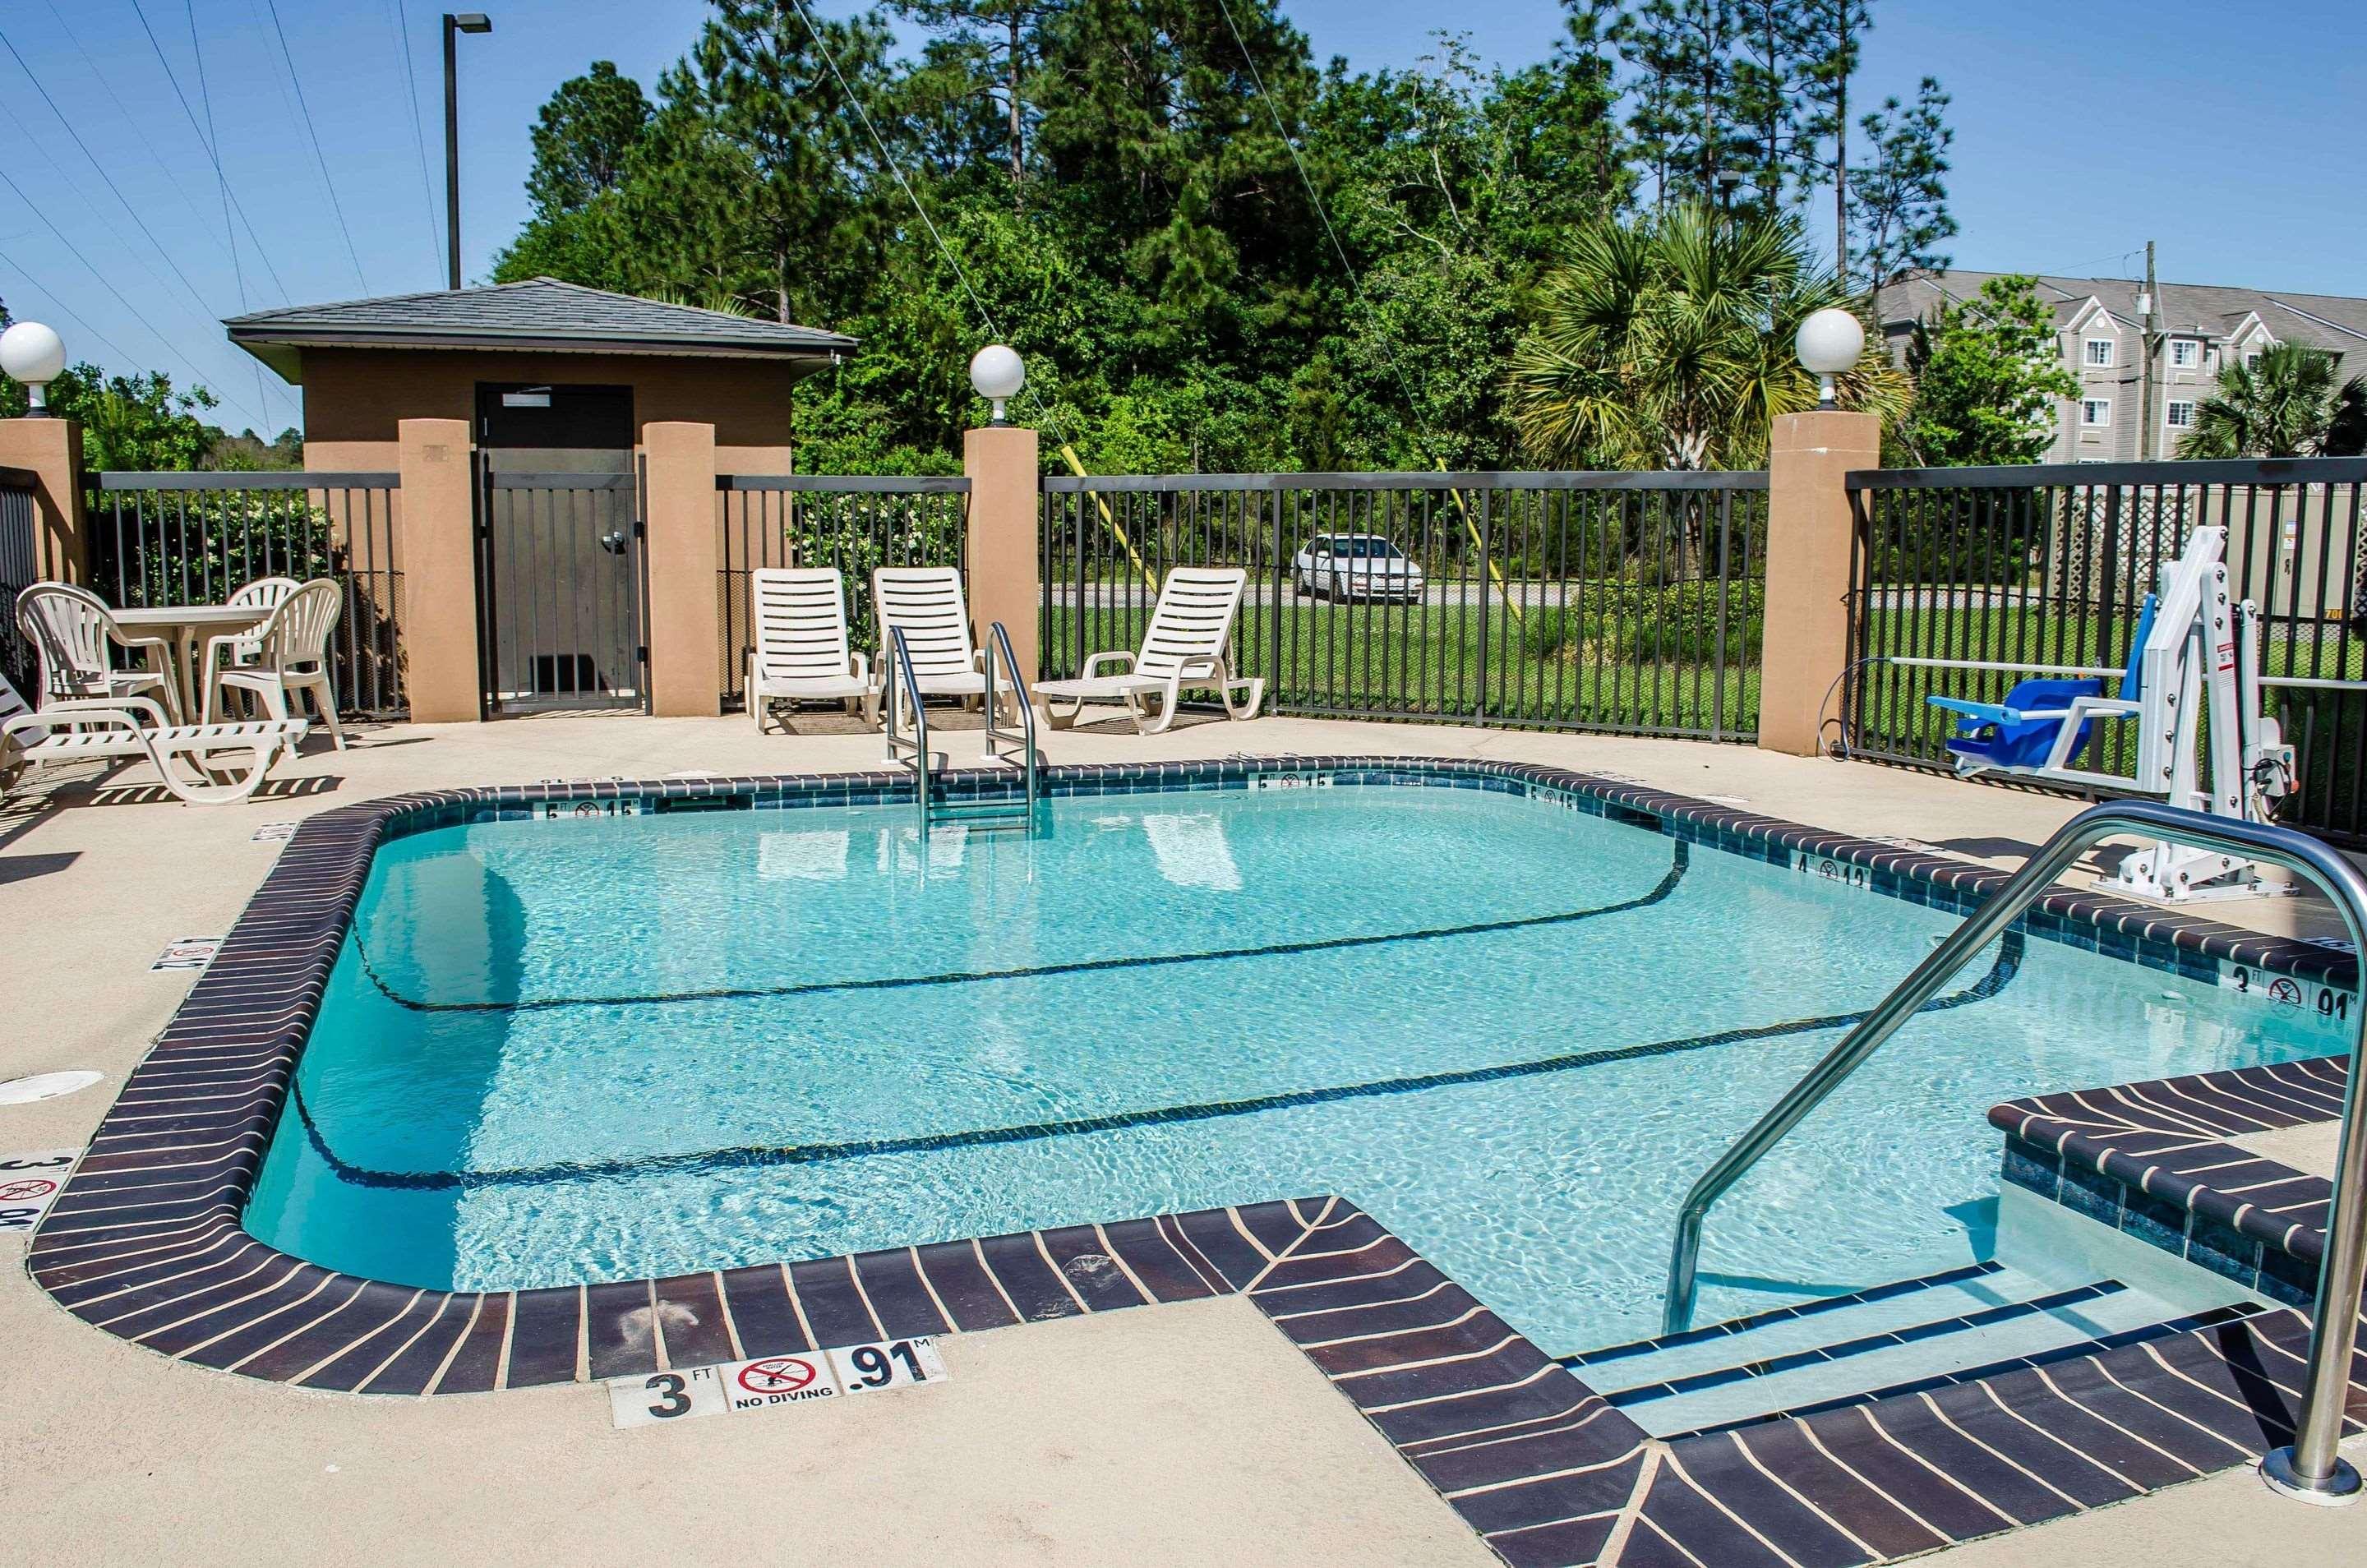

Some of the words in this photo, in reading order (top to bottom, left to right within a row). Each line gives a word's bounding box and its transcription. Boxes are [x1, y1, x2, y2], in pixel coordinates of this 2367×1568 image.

[1258, 774, 1267, 789] 5
[546, 803, 558, 819] 5
[849, 1340, 927, 1390] .91
[913, 1338, 930, 1348] M
[645, 1374, 692, 1418] 3
[693, 1367, 712, 1381] FT
[736, 1397, 763, 1409] NO
[768, 1387, 833, 1404] DIVING
